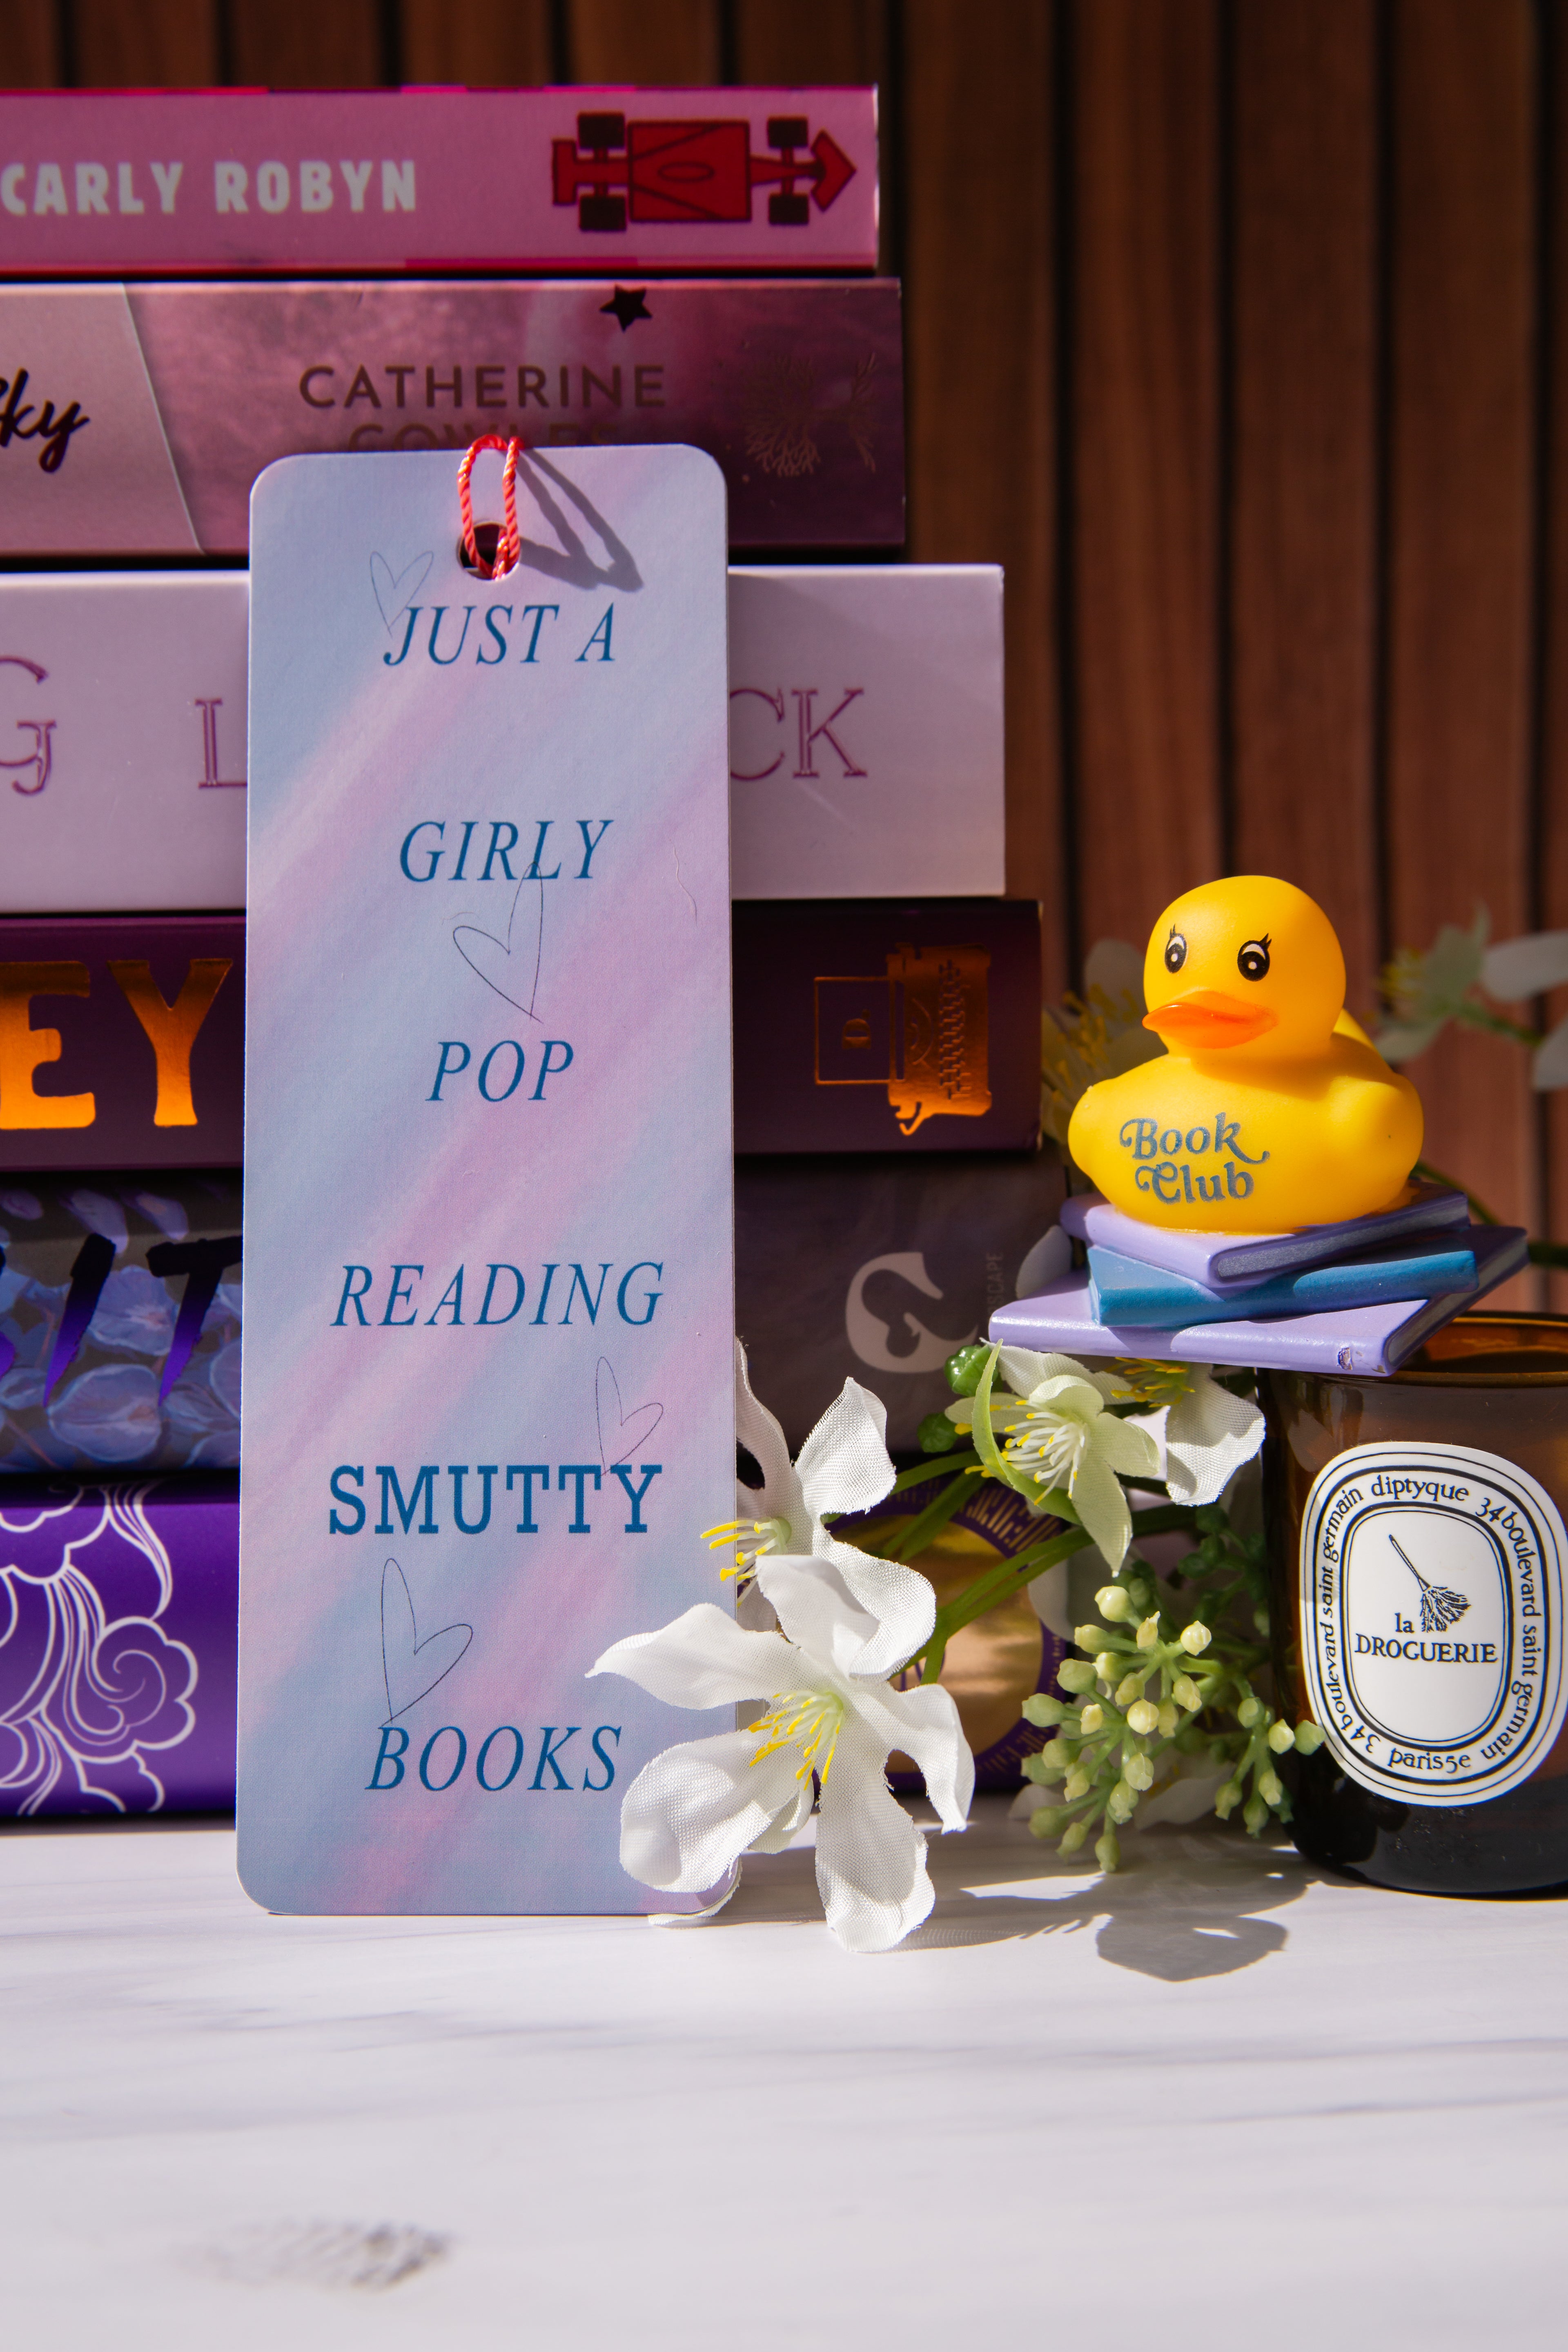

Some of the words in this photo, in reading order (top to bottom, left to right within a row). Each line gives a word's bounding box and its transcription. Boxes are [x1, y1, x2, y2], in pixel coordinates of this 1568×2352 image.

[0, 161, 183, 216] CARLY
[214, 160, 416, 214] ROBYN
[298, 365, 666, 408] CATHERINE
[0, 366, 90, 474] ky
[384, 605, 560, 666] JUST
[575, 603, 614, 663] A
[399, 819, 614, 883] GIRLY
[425, 1040, 575, 1102] POP
[1119, 1112, 1270, 1165] Book
[1135, 1161, 1255, 1205] Club
[329, 1261, 664, 1327] READING
[329, 1462, 664, 1536] SMUTTY
[1371, 1474, 1470, 1502] diptyque
[1323, 1488, 1365, 1564] germain
[1318, 1565, 1334, 1619] saint
[1354, 1633, 1499, 1664] DROGUERIE
[1394, 1612, 1415, 1633] la
[1522, 1624, 1542, 1677] saint
[1480, 1680, 1533, 1760] germain
[363, 1724, 623, 1792] BOOKS
